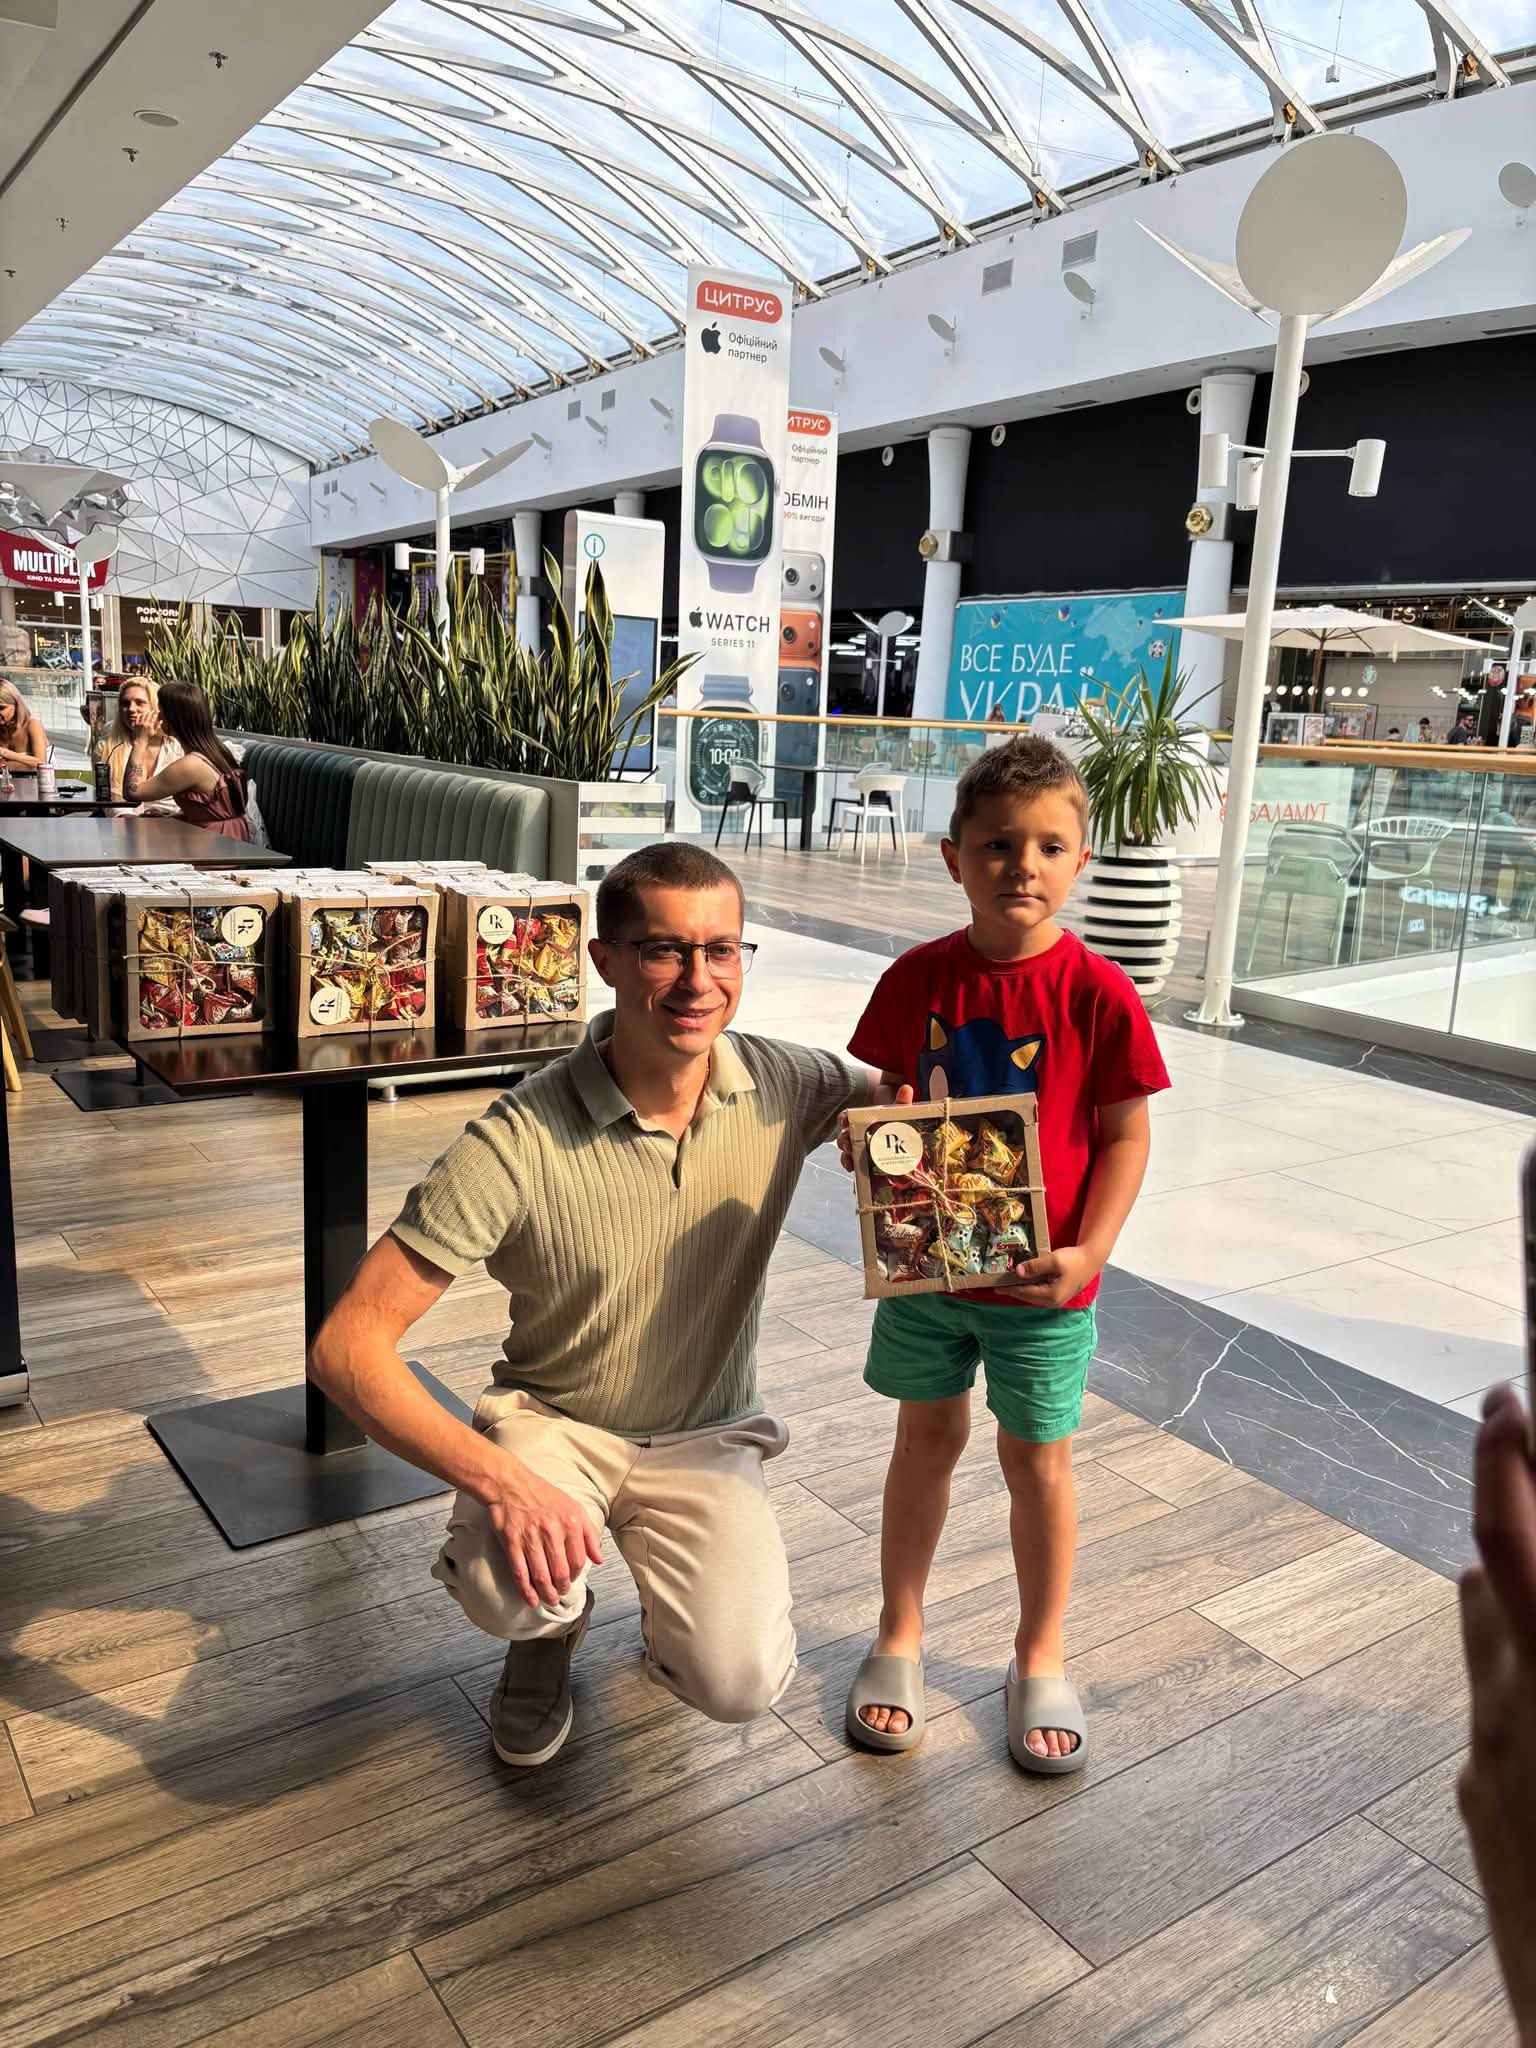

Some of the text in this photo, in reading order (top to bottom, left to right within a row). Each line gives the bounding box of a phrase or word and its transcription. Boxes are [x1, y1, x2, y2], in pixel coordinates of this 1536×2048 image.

[704, 287, 776, 316] ЦИТРУС
[728, 332, 778, 351] Офіційний
[728, 348, 767, 364] партнер
[787, 415, 826, 431] ИТРУС
[13, 549, 96, 578] MULTIPLX
[706, 612, 770, 633] WATCH
[1464, 610, 1494, 619] DESSE
[711, 637, 745, 648] SERIES
[959, 643, 1076, 677] ВСЕ БУДЕ
